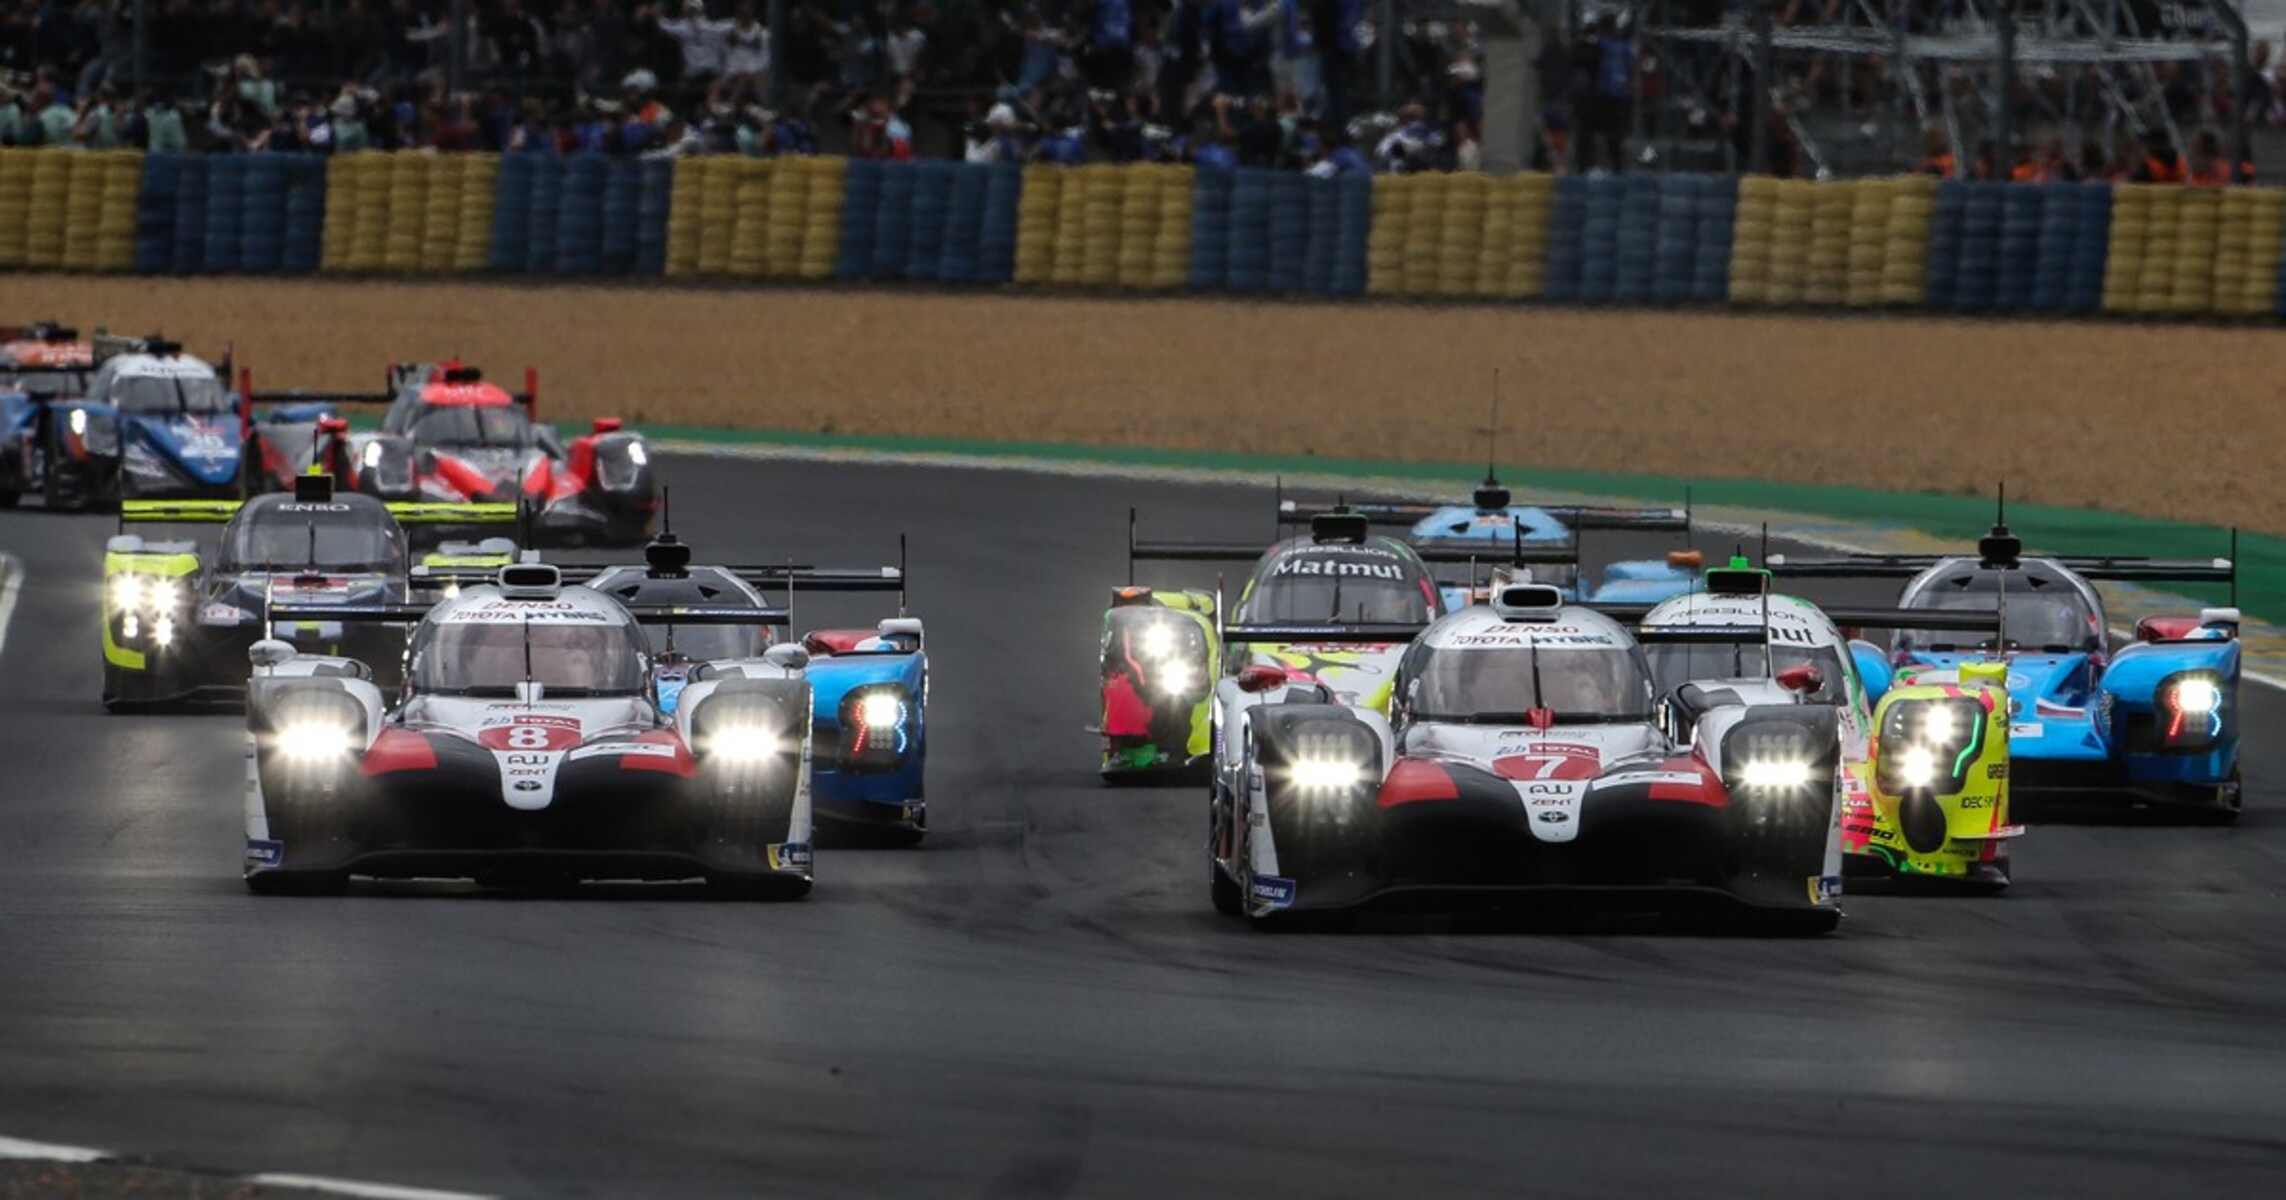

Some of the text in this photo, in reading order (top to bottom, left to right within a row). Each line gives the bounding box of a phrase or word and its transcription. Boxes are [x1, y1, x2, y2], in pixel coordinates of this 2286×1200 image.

[1272, 559, 1405, 580] Matmut
[482, 601, 574, 610] DENSO
[452, 609, 518, 620] TOYOTA
[1485, 624, 1580, 634] DENSO
[1452, 634, 1523, 645] TOYOTA
[518, 717, 579, 726] TOTAL
[507, 725, 550, 749] 8
[1535, 745, 1593, 754] TOTAL
[508, 767, 549, 776] ZENT
[1524, 755, 1568, 779] 7
[1530, 798, 1573, 806] ZENT
